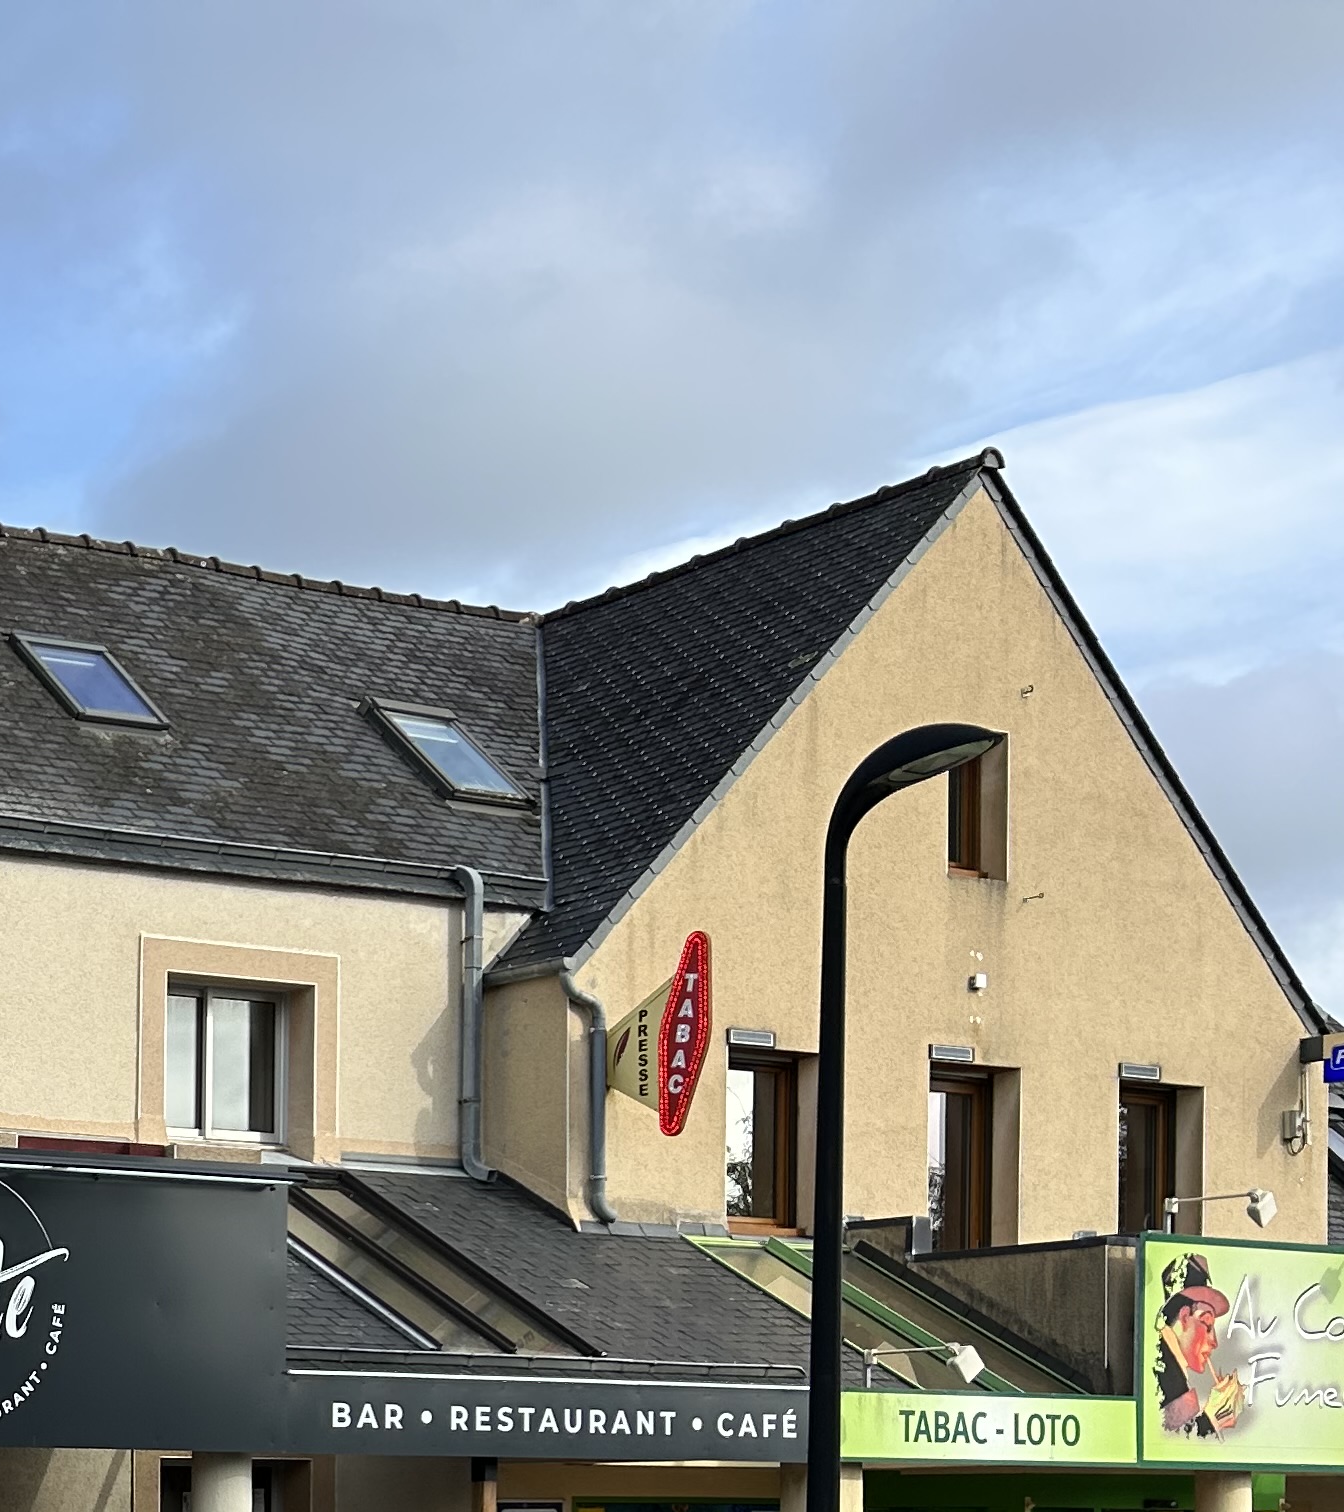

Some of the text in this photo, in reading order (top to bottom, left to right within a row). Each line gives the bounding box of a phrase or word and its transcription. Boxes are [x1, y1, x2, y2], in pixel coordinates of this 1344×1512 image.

[637, 1008, 650, 1098] PRESSE
[667, 972, 699, 1096] TABAC
[44, 1301, 66, 1356] CAFÉ
[1226, 1273, 1279, 1340] Au
[1247, 1351, 1344, 1409] Fume
[331, 1401, 799, 1439] BAR RESTAURANT CAFÉ
[898, 1409, 1082, 1447] TABAC LOTO
